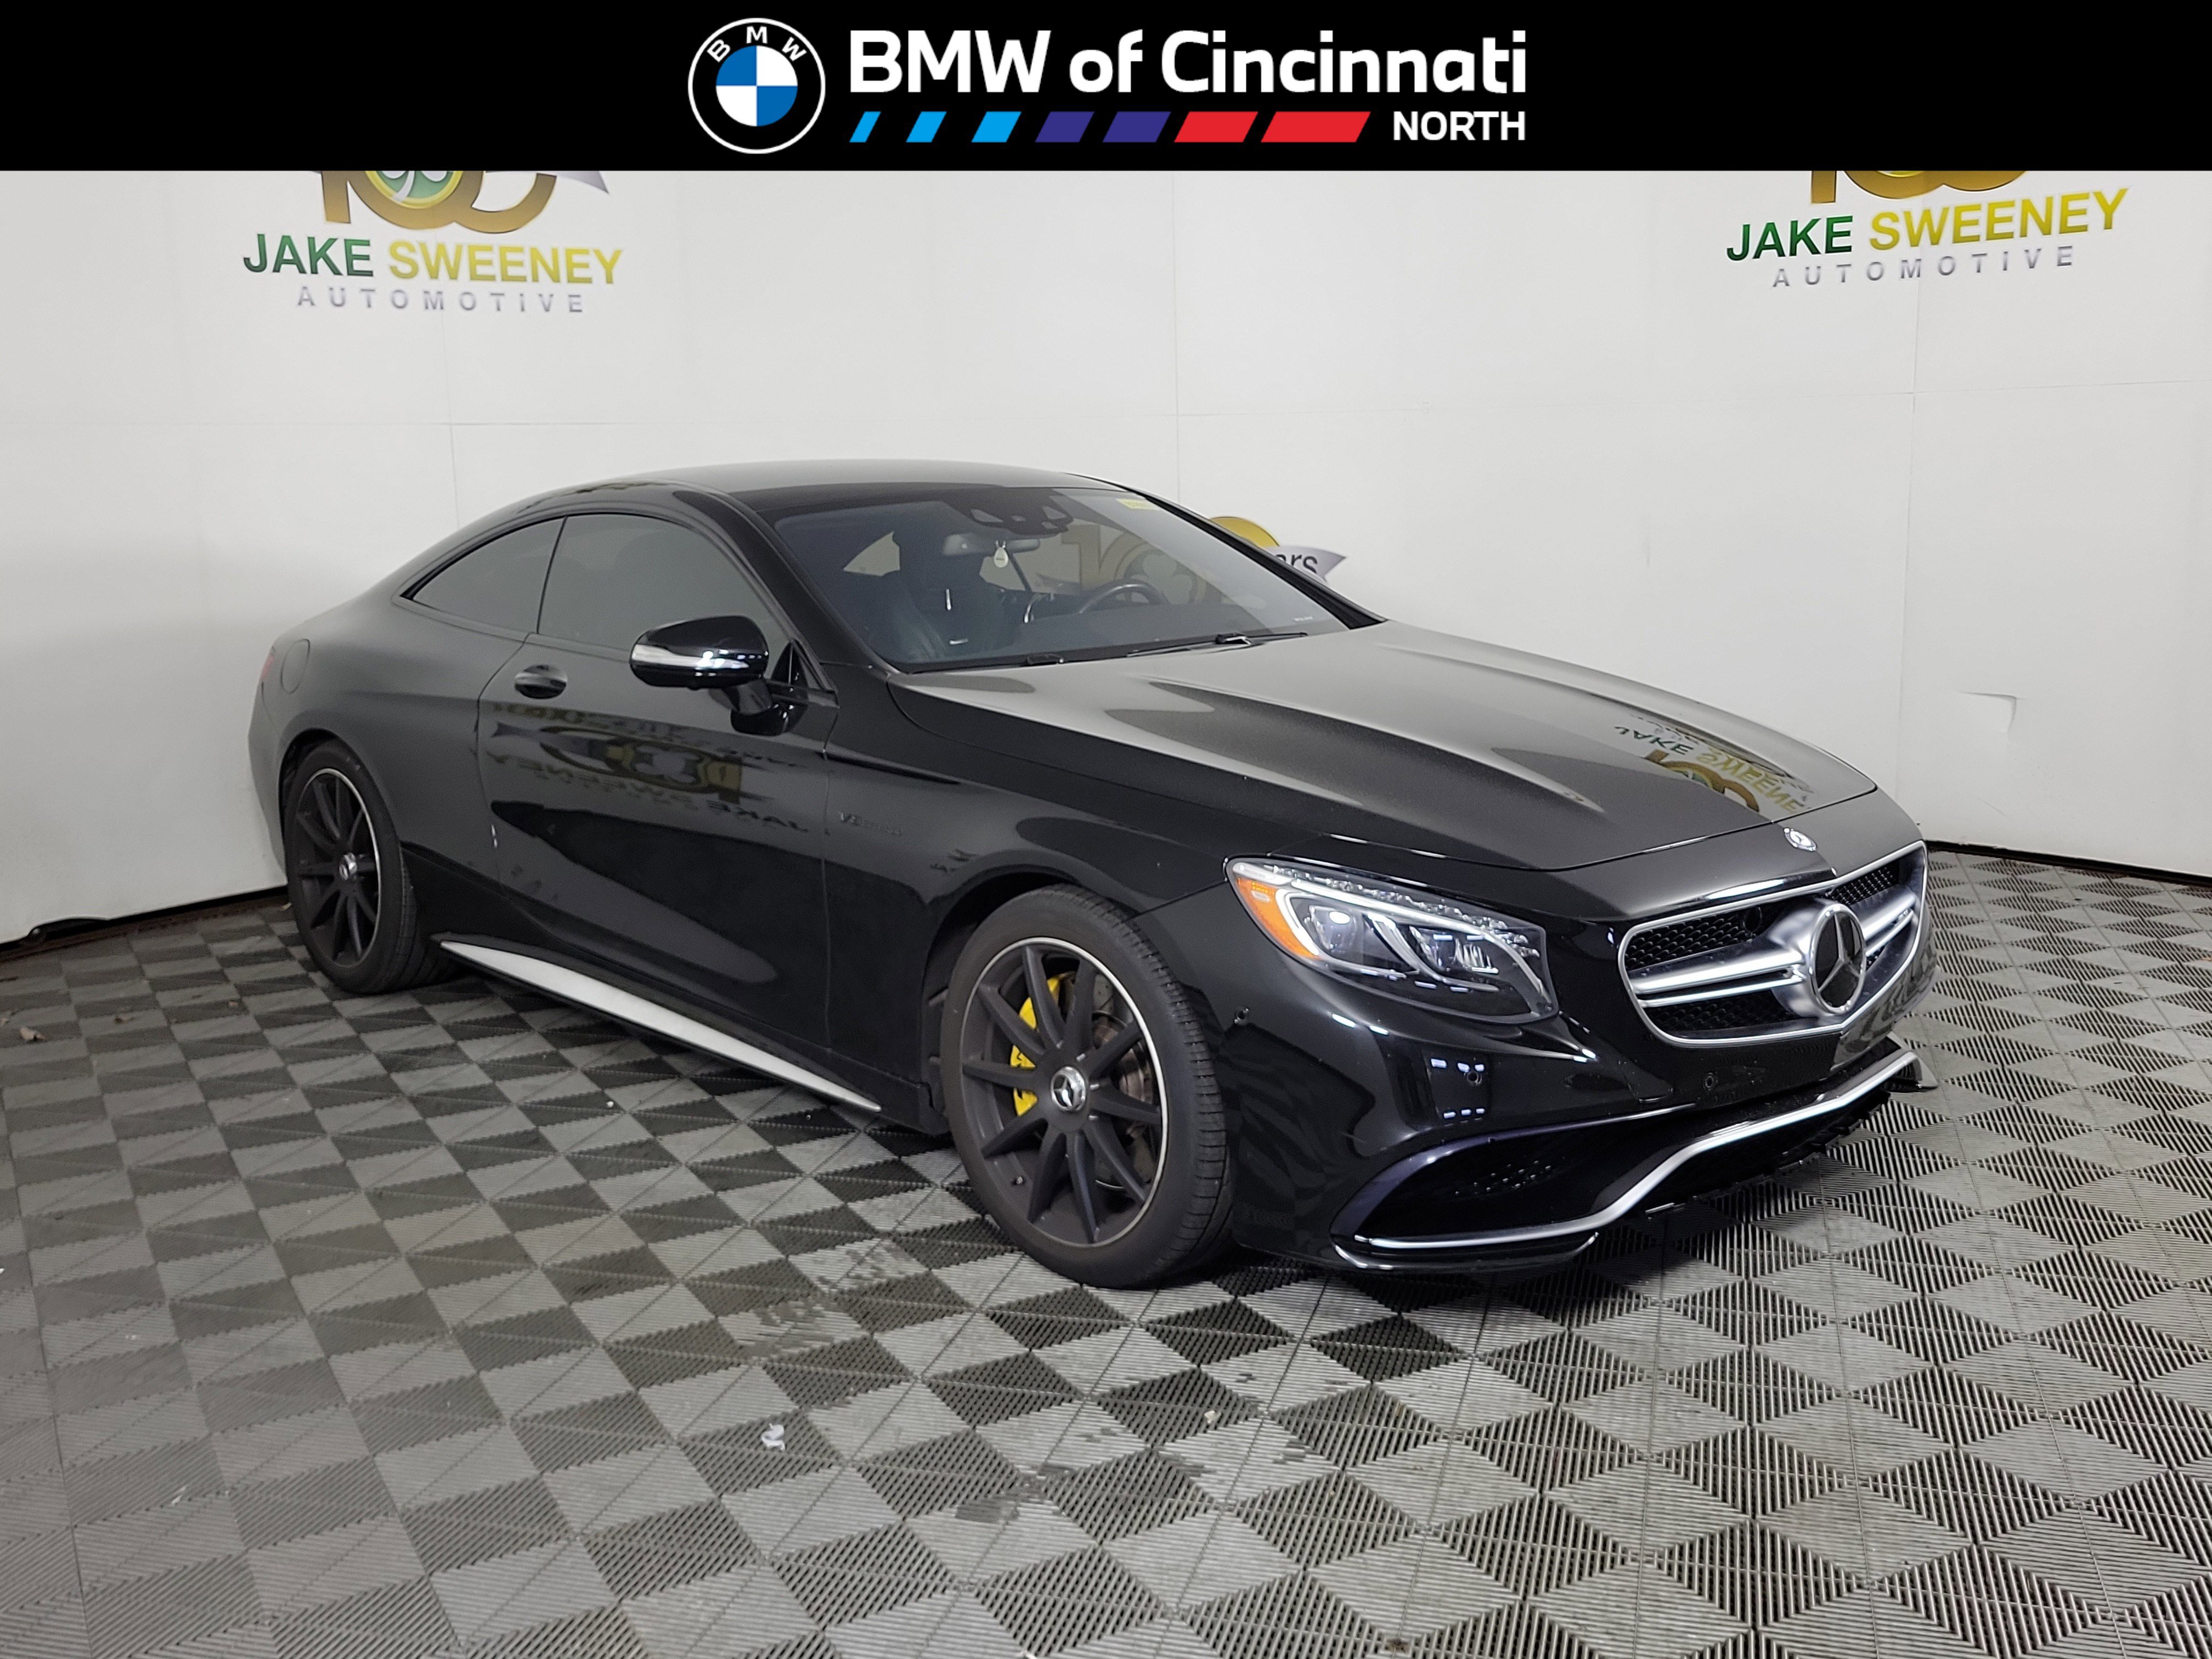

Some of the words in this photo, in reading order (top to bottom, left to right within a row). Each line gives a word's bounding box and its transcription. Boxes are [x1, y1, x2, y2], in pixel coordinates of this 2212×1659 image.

[1726, 215, 1854, 262] JAKE
[1869, 188, 2129, 251] SWEENEY
[242, 233, 374, 277] JAKE
[388, 240, 622, 284] SWEENEY
[1772, 245, 2074, 288] AUTOMOTIVE
[297, 286, 583, 313] AUTOMOTIVE
